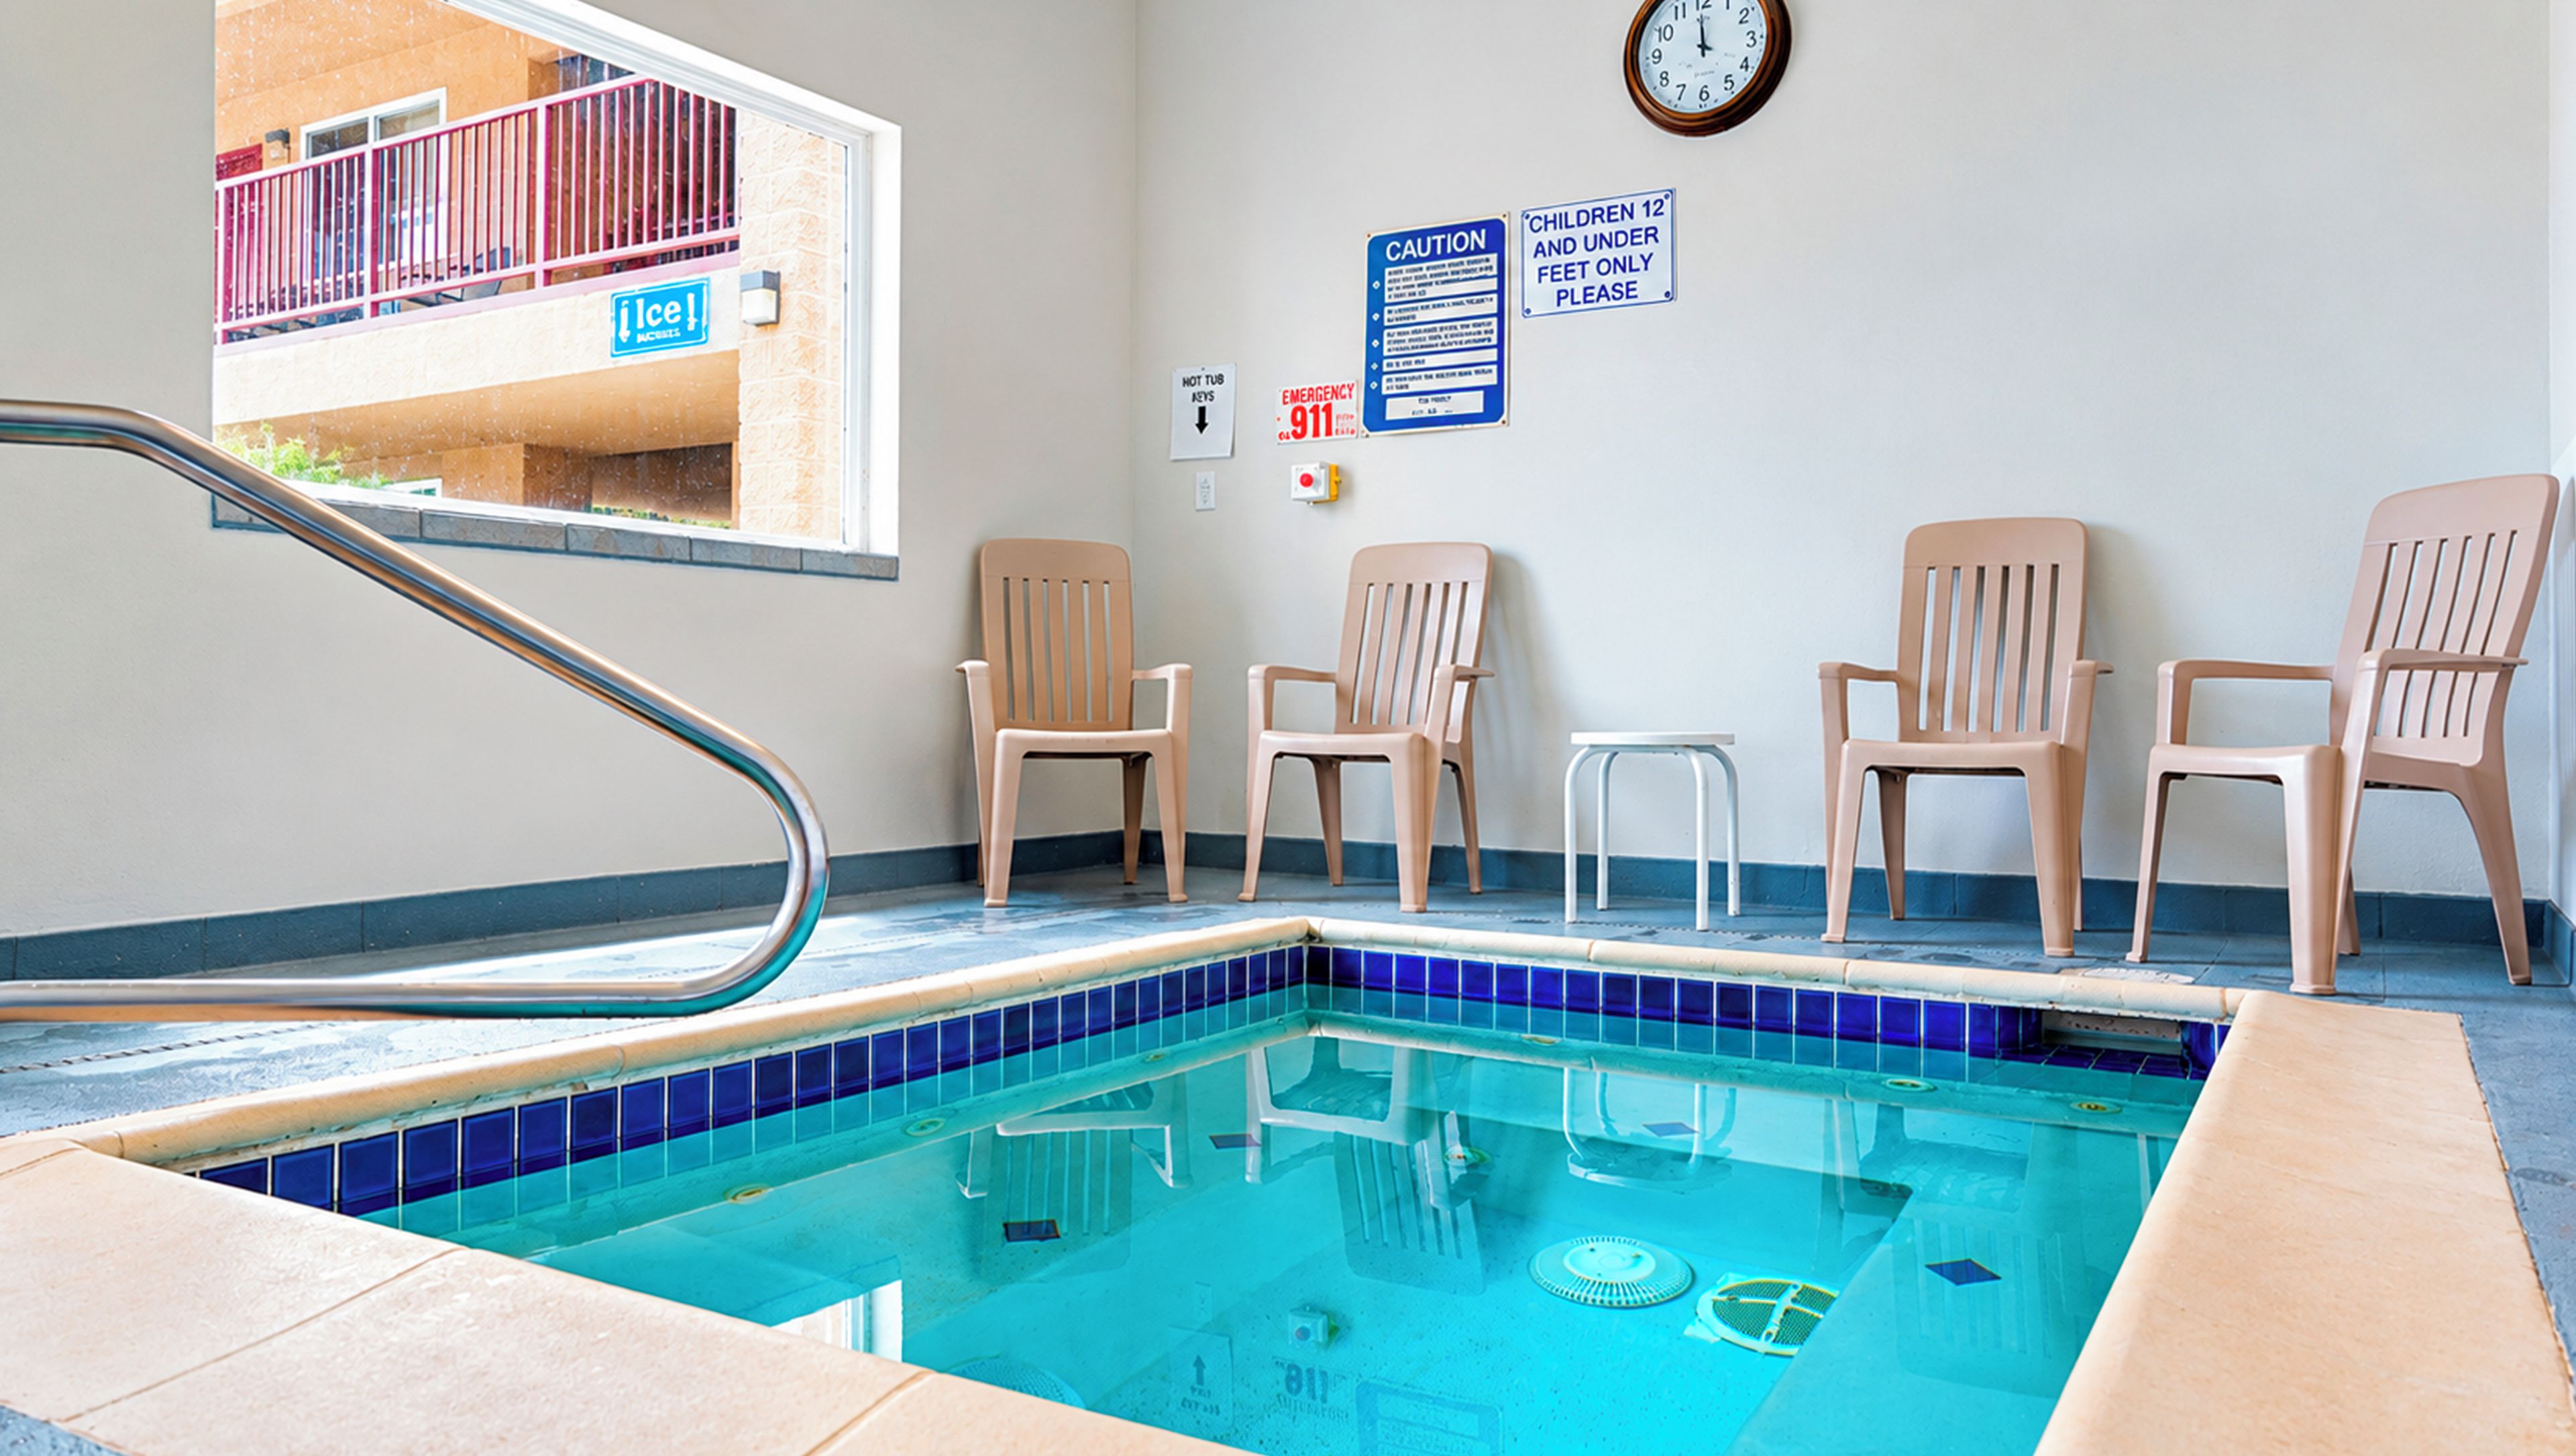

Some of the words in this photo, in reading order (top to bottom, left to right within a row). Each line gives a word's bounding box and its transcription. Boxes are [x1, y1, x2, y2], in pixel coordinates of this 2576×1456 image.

[1674, 2, 1686, 20] 11
[1738, 7, 1750, 25] 2
[1654, 24, 1674, 42] 10
[1746, 30, 1757, 48] 3
[1652, 48, 1662, 64] 9
[1739, 56, 1750, 72] 4
[1659, 70, 1670, 87] 8
[1723, 74, 1735, 91] 5
[1676, 84, 1686, 101] 7
[1699, 85, 1710, 102] 6
[1529, 202, 1635, 233] CHILDREN
[1642, 198, 1664, 218] 12
[1386, 229, 1486, 262] CAUTION
[1533, 237, 1577, 258] AND
[1583, 225, 1660, 252] UNDER
[1538, 260, 1591, 284] FEET
[1595, 252, 1654, 276] ONLY
[1556, 280, 1638, 307] PLEASE
[1182, 374, 1202, 388] HOT
[1205, 373, 1225, 386] TUB
[1191, 391, 1215, 403] KEYS
[1282, 382, 1355, 406] EMERGENCY
[1290, 403, 1333, 440] 911
